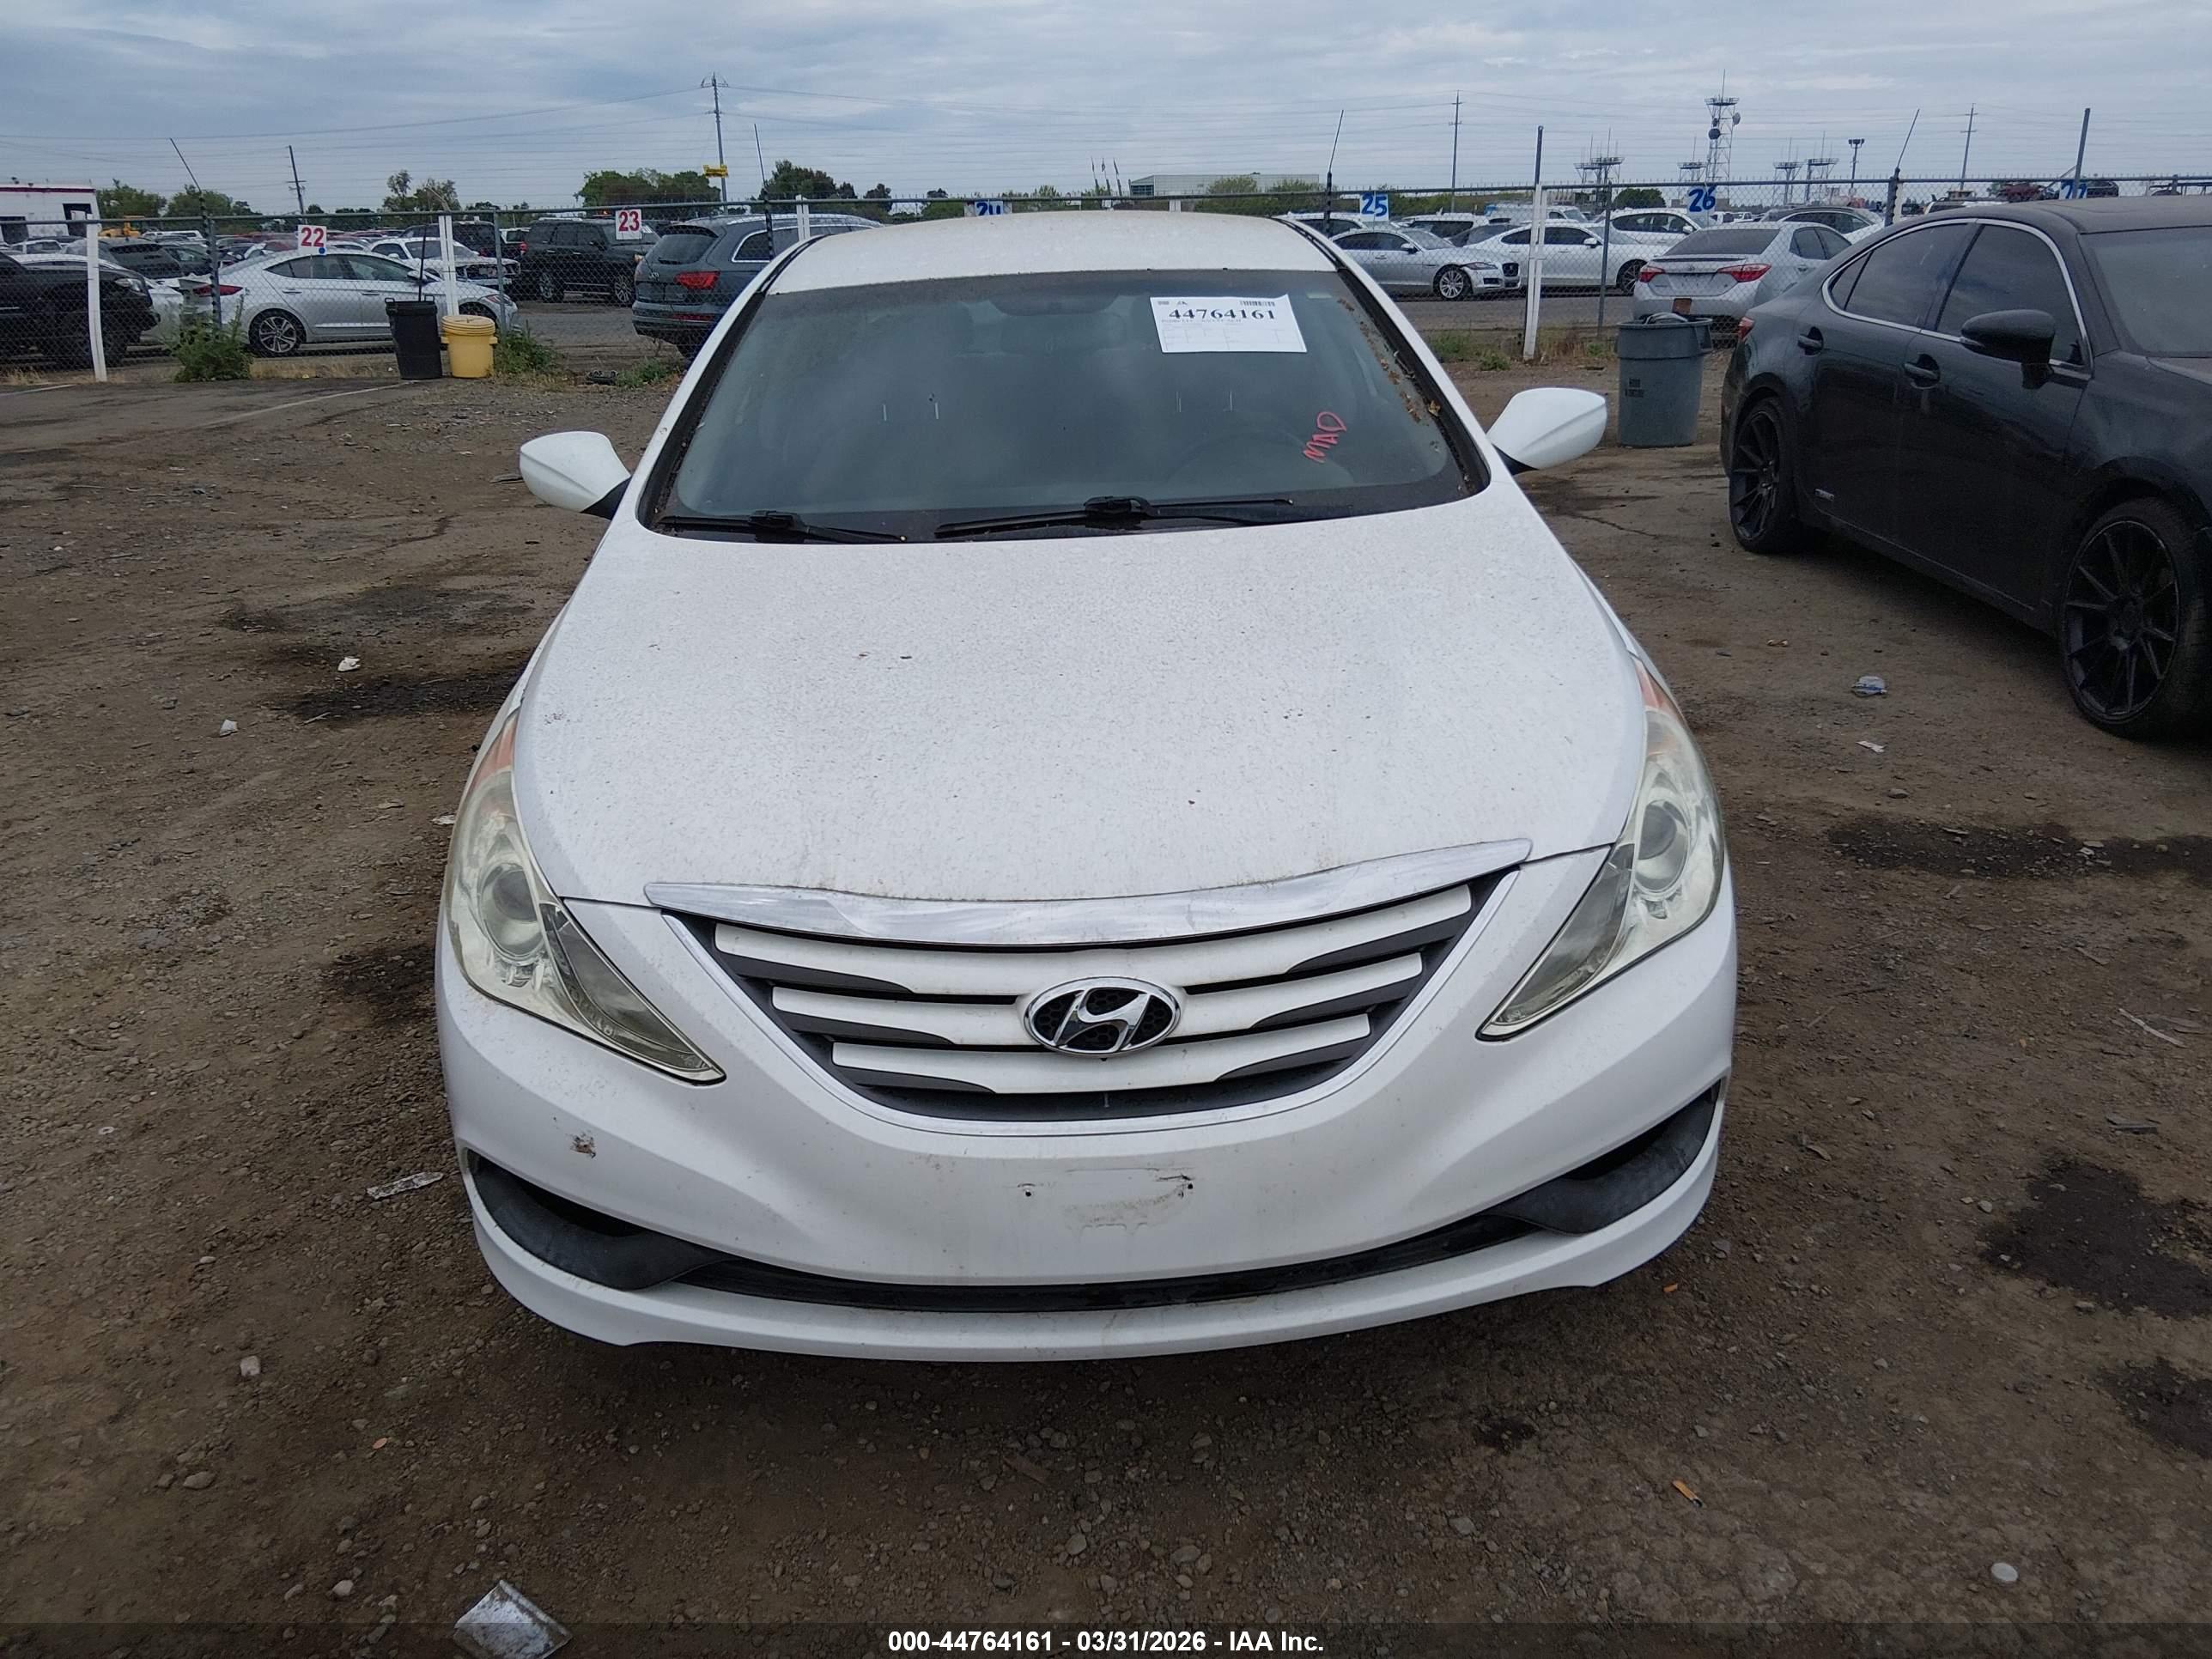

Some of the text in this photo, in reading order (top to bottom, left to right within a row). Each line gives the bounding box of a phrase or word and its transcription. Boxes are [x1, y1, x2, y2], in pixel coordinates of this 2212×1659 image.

[1361, 192, 1388, 217] 25
[1688, 184, 1717, 212] 26
[618, 210, 640, 232] 23
[301, 227, 325, 247] 22
[1169, 308, 1275, 320] 44764161
